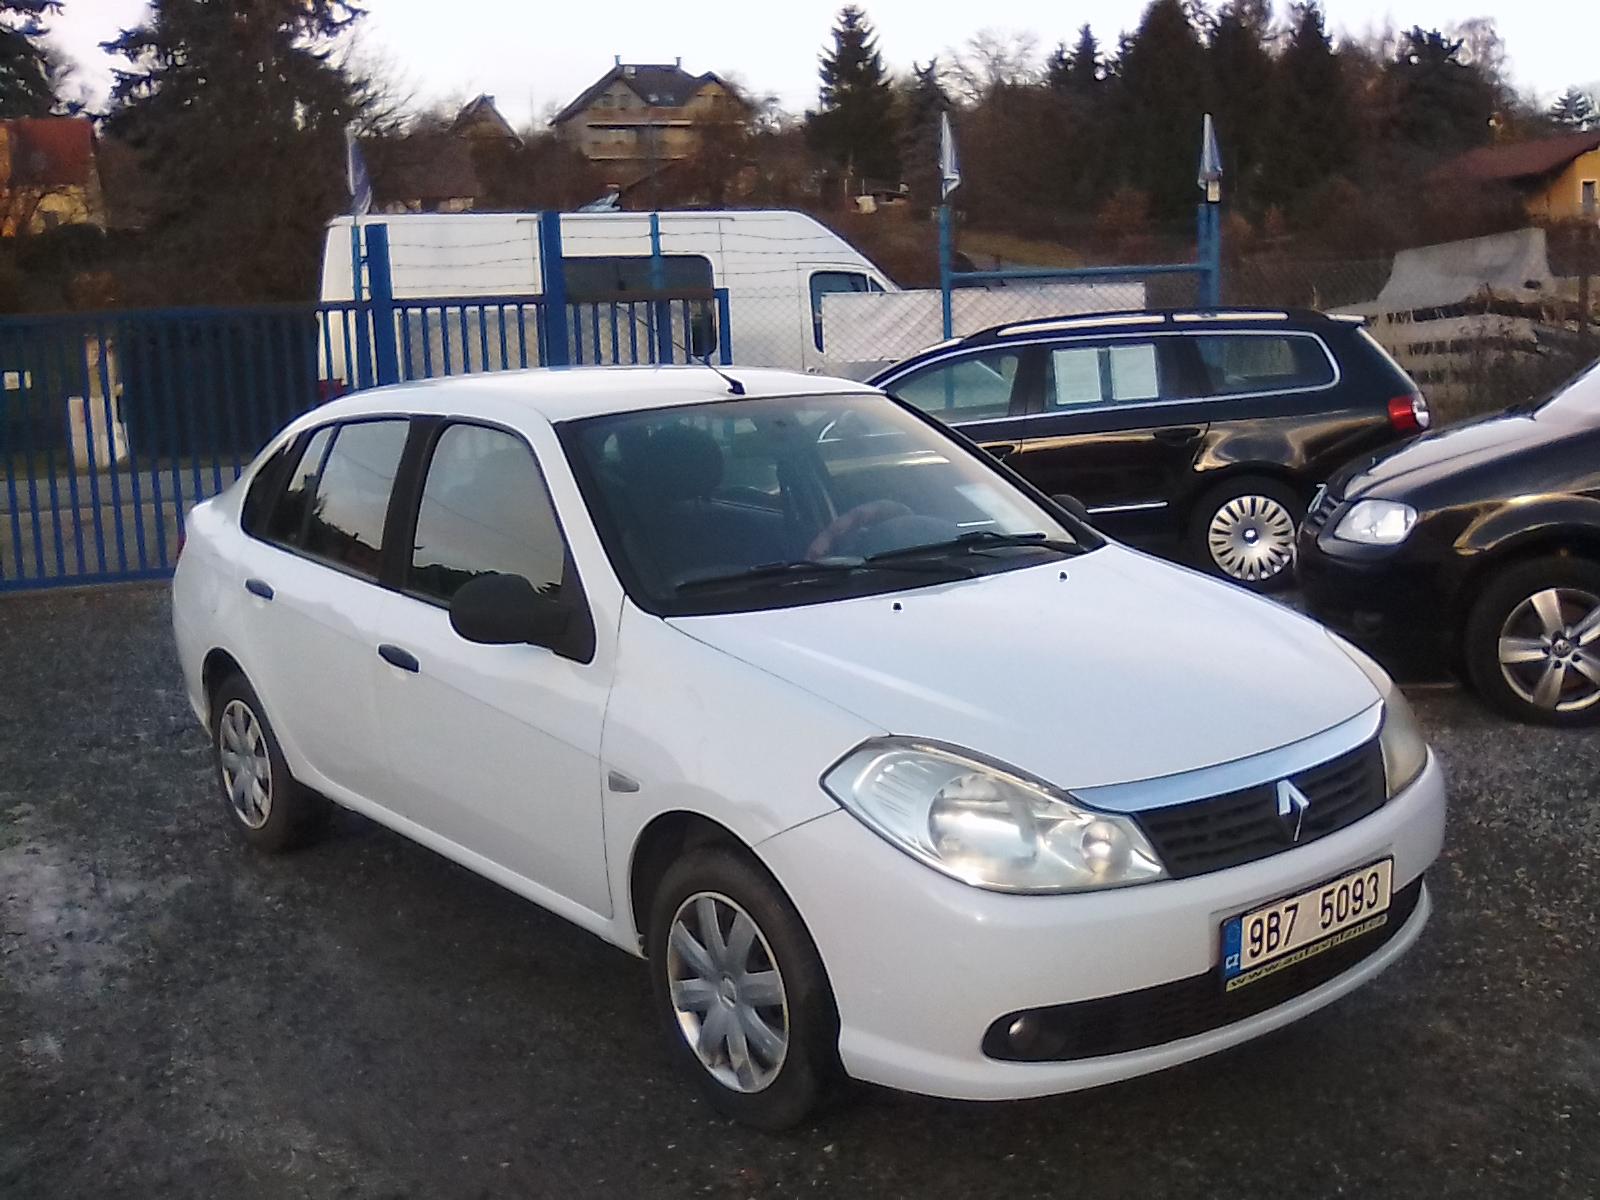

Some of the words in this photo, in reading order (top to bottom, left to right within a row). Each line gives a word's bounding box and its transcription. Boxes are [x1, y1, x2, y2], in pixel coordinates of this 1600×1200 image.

[1249, 903, 1300, 958] 9B7
[1321, 872, 1380, 929] 5093
[1226, 953, 1239, 969] CZ
